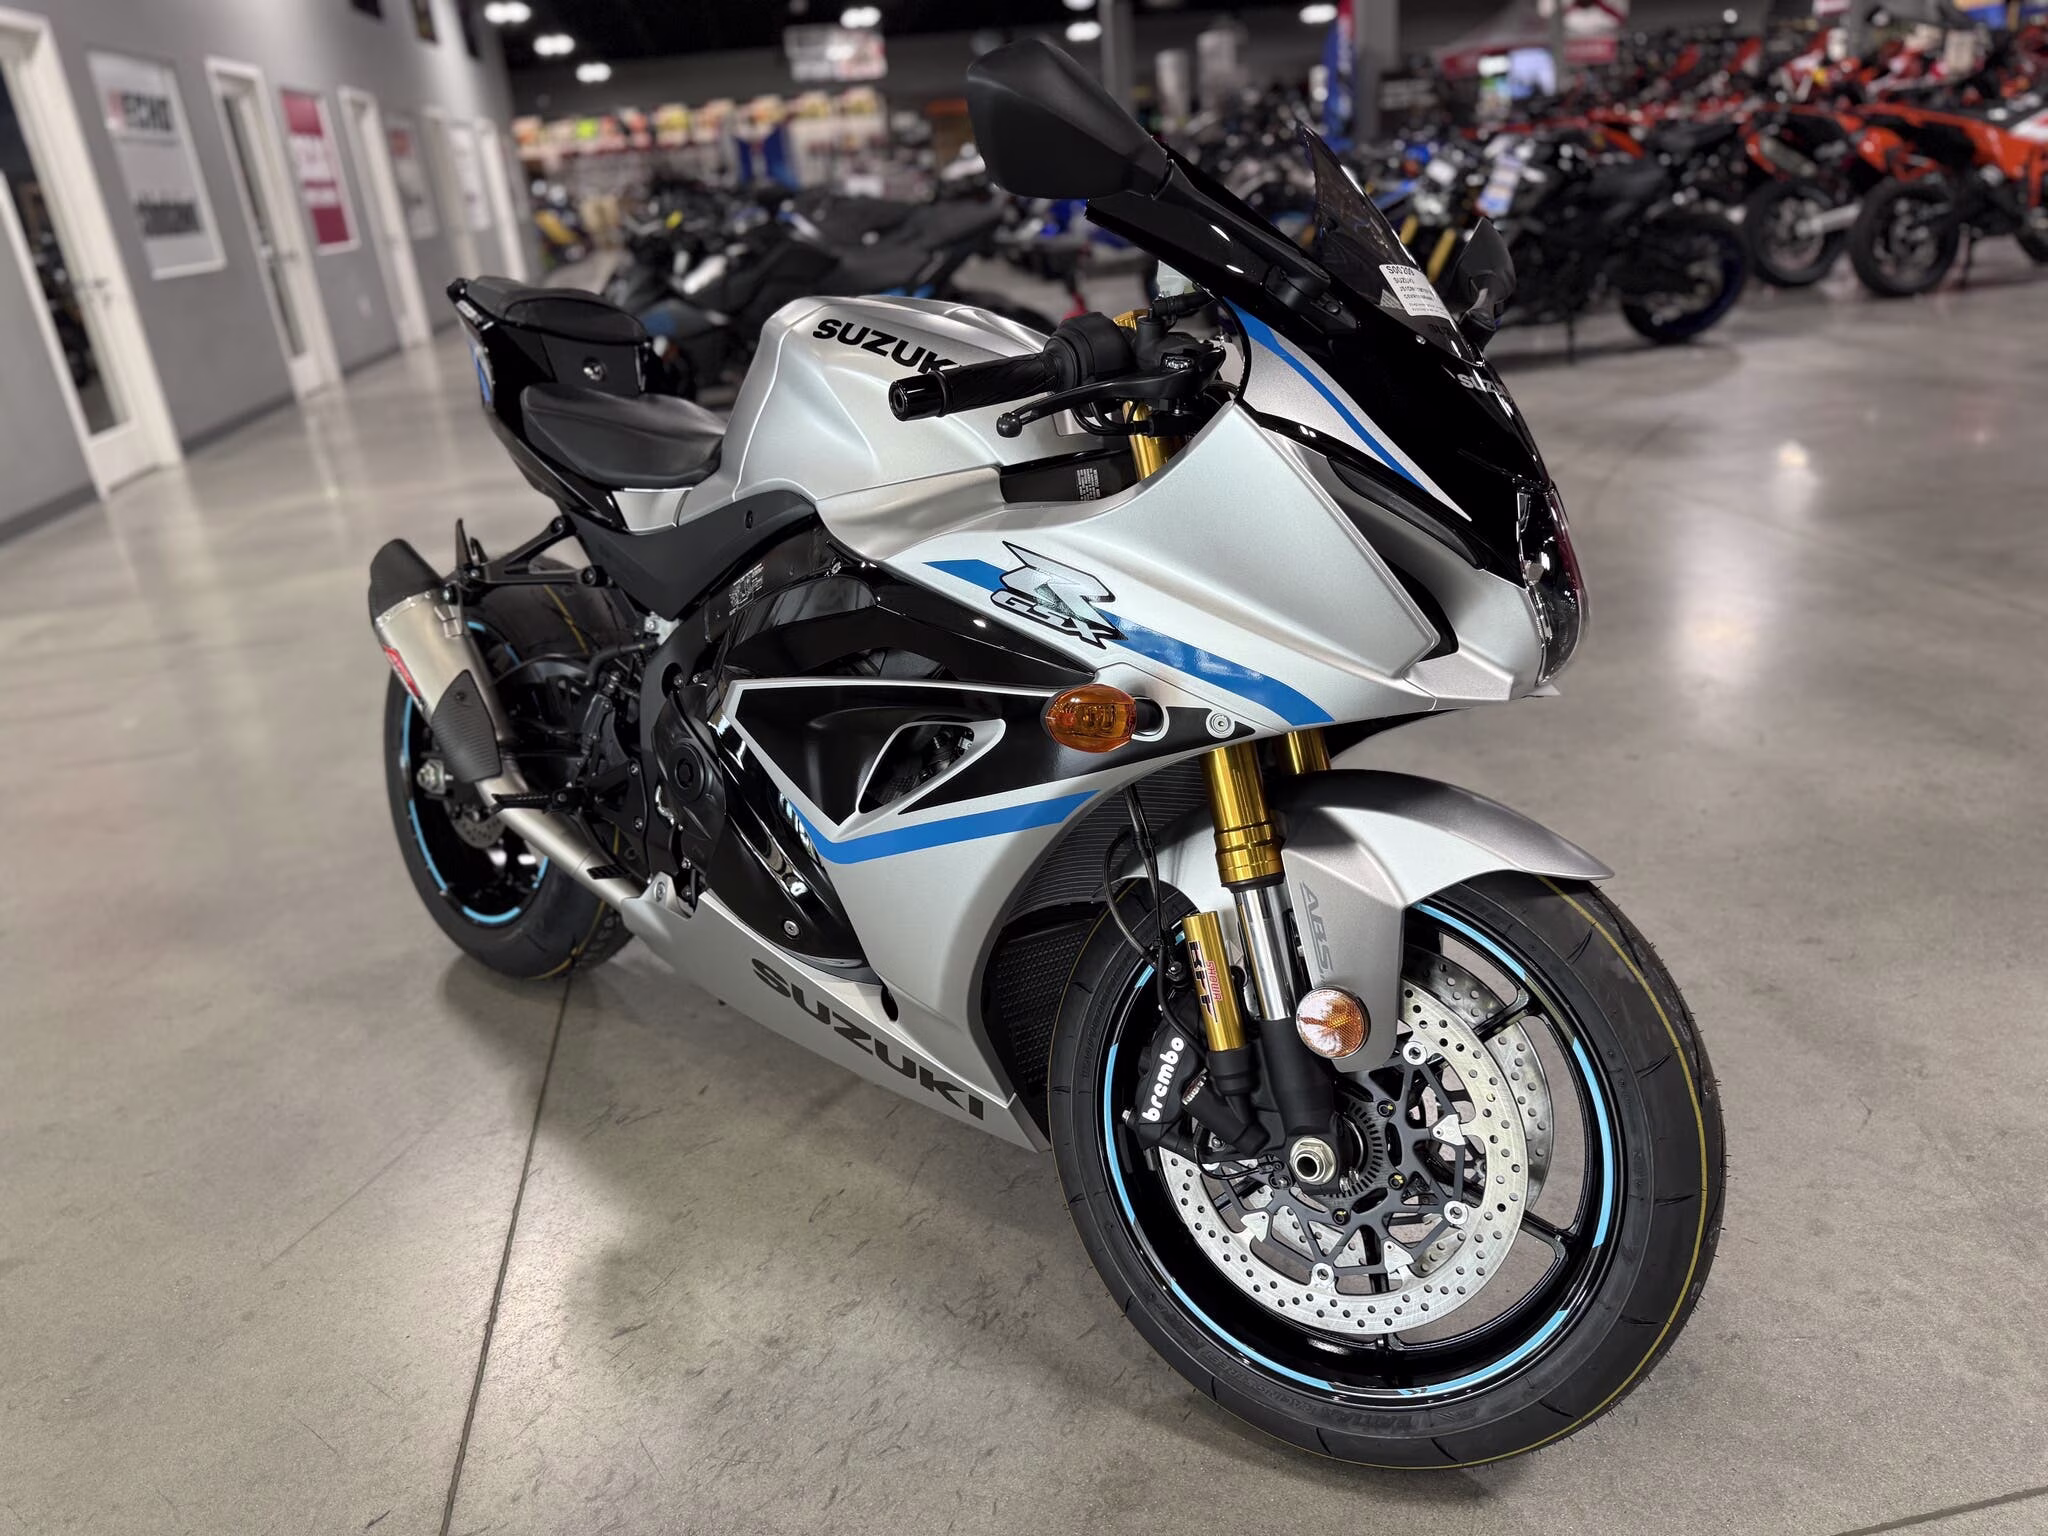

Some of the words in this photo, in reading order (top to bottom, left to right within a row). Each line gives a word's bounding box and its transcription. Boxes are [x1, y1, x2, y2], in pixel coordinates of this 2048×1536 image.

[812, 318, 961, 375] SUZUK
[1299, 881, 1334, 975] ABS
[1206, 960, 1223, 1002] SHOWA
[752, 958, 984, 1121] SUZUKI
[1141, 1037, 1185, 1122] brembo
